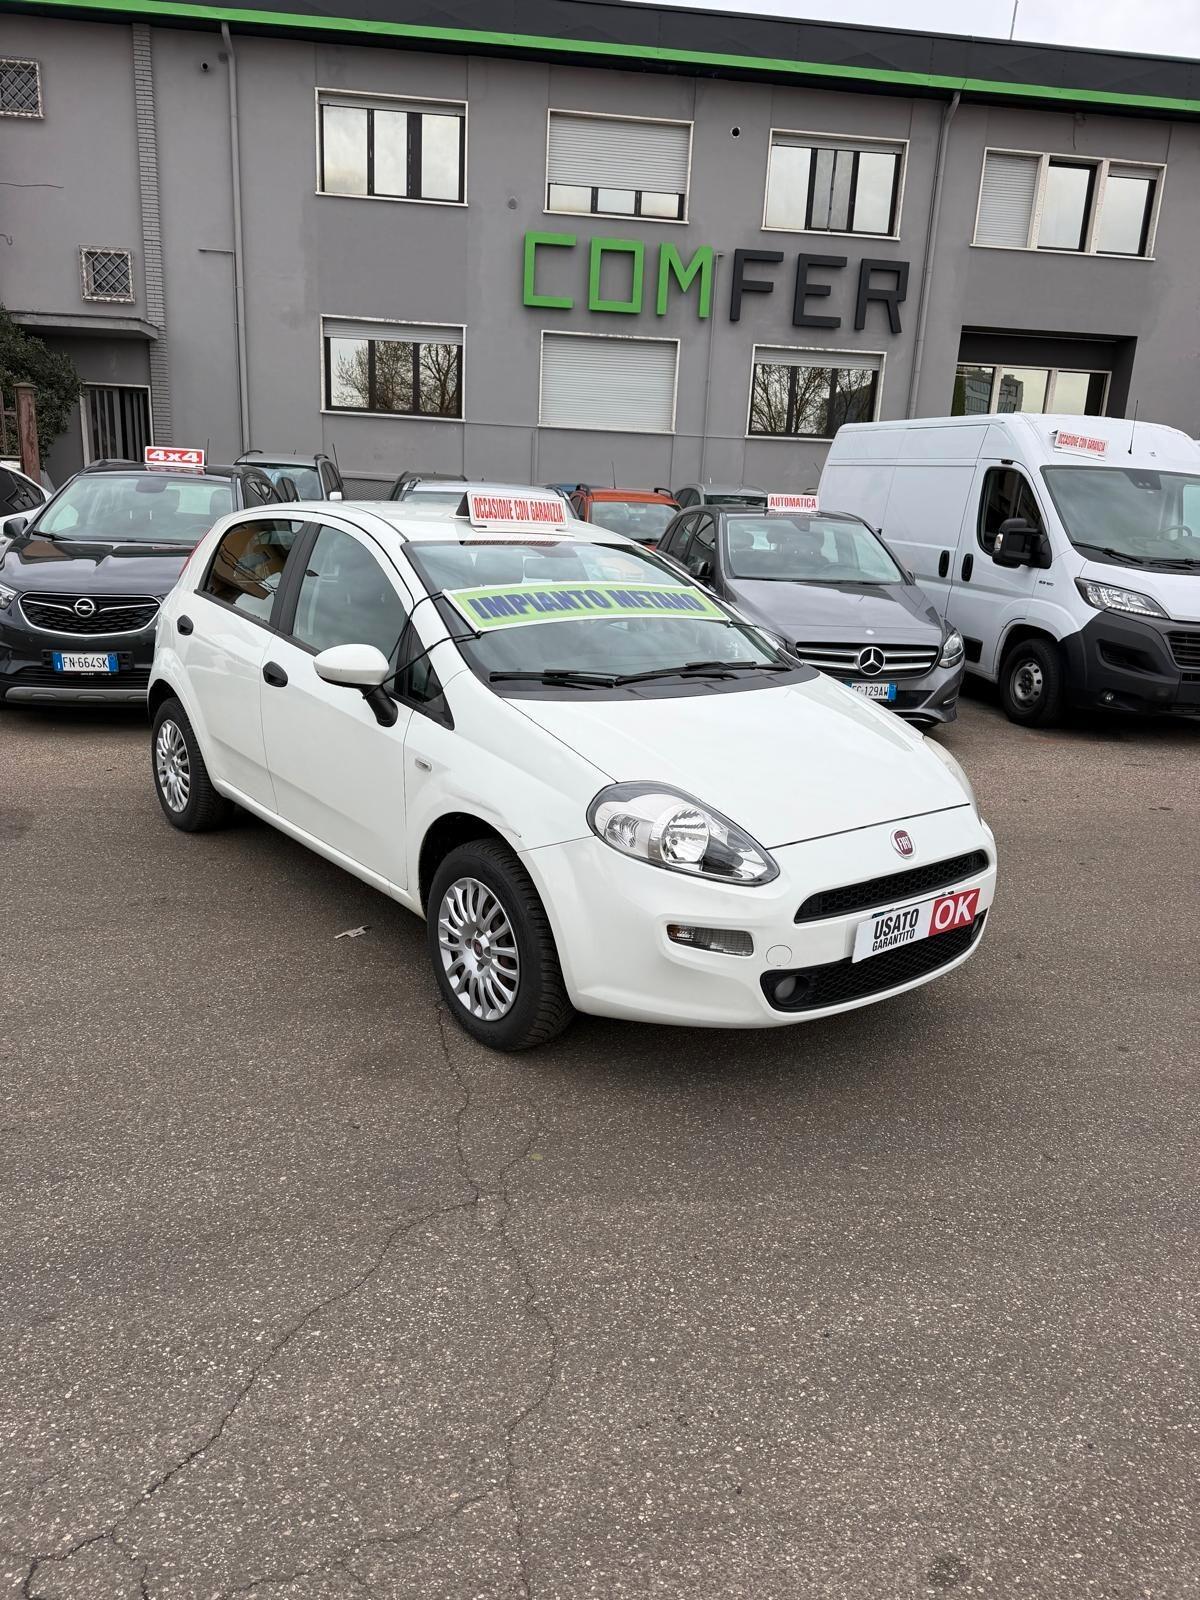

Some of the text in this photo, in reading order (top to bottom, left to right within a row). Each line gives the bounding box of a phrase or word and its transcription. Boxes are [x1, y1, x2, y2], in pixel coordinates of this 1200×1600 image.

[523, 231, 910, 333] COMFER
[148, 448, 200, 464] 4x4
[473, 497, 564, 523] OCCASIONE CON GARANZIA
[769, 496, 817, 509] AUTOMATICA
[466, 588, 707, 620] IMPIANTO METANO
[873, 892, 976, 940] USATO OK
[872, 928, 915, 952] GARANTITO
